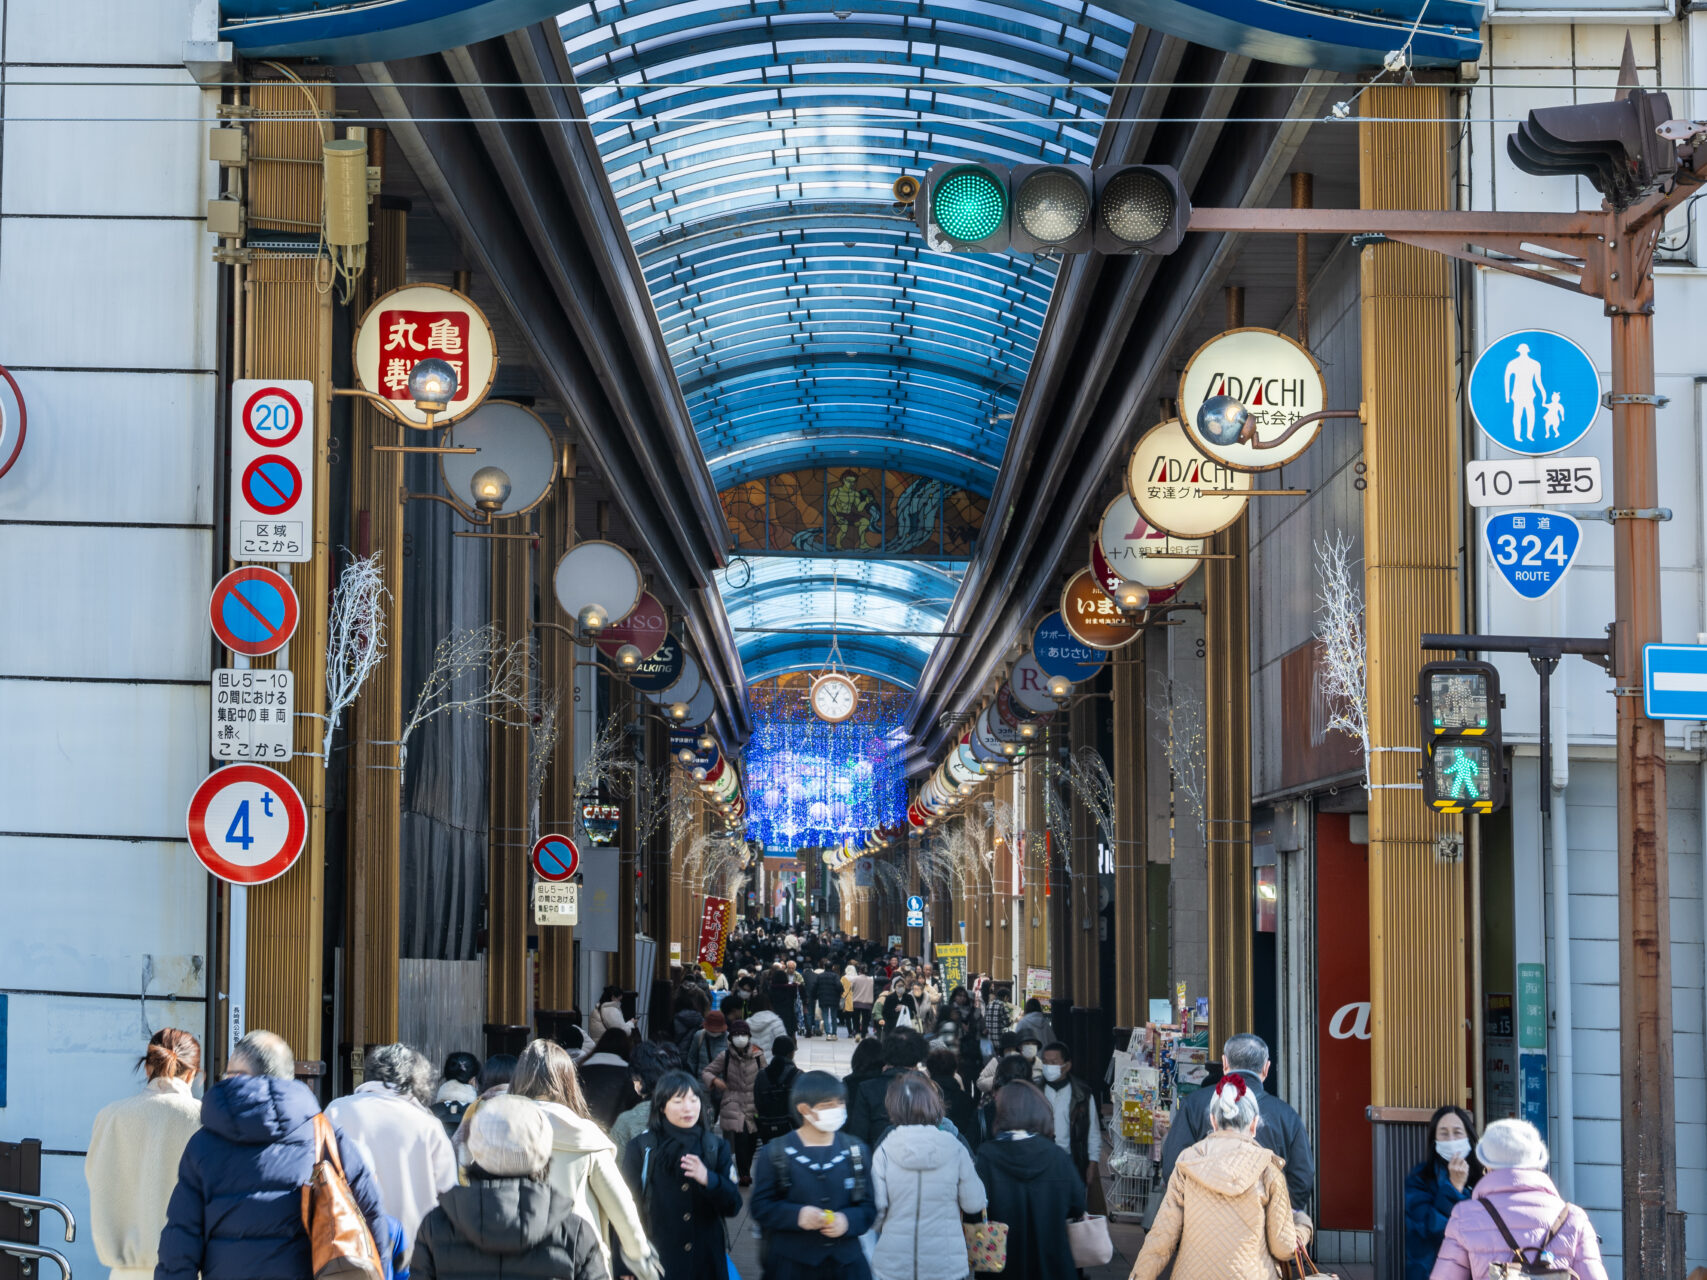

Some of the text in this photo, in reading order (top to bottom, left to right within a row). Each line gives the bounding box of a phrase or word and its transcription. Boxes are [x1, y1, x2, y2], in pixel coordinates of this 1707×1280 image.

[384, 318, 463, 354] 丸亀
[1203, 373, 1305, 407] ADACHI
[255, 404, 289, 431] 20
[1253, 410, 1304, 426] 式会社
[1148, 456, 1234, 483] ADACHI
[1148, 486, 1234, 499] 安達グルプ
[256, 524, 287, 537] 区域
[1512, 516, 1551, 530] 国道
[244, 540, 299, 553] ここから
[1496, 534, 1568, 567] 324
[1515, 571, 1551, 582] ROUTE
[1077, 597, 1122, 615] いま
[1047, 646, 1092, 659] あじさい
[636, 663, 673, 673] ALKING
[217, 690, 287, 705] の間における
[217, 724, 240, 740] を除く
[219, 742, 287, 757] ここから
[583, 807, 619, 819] CAFE
